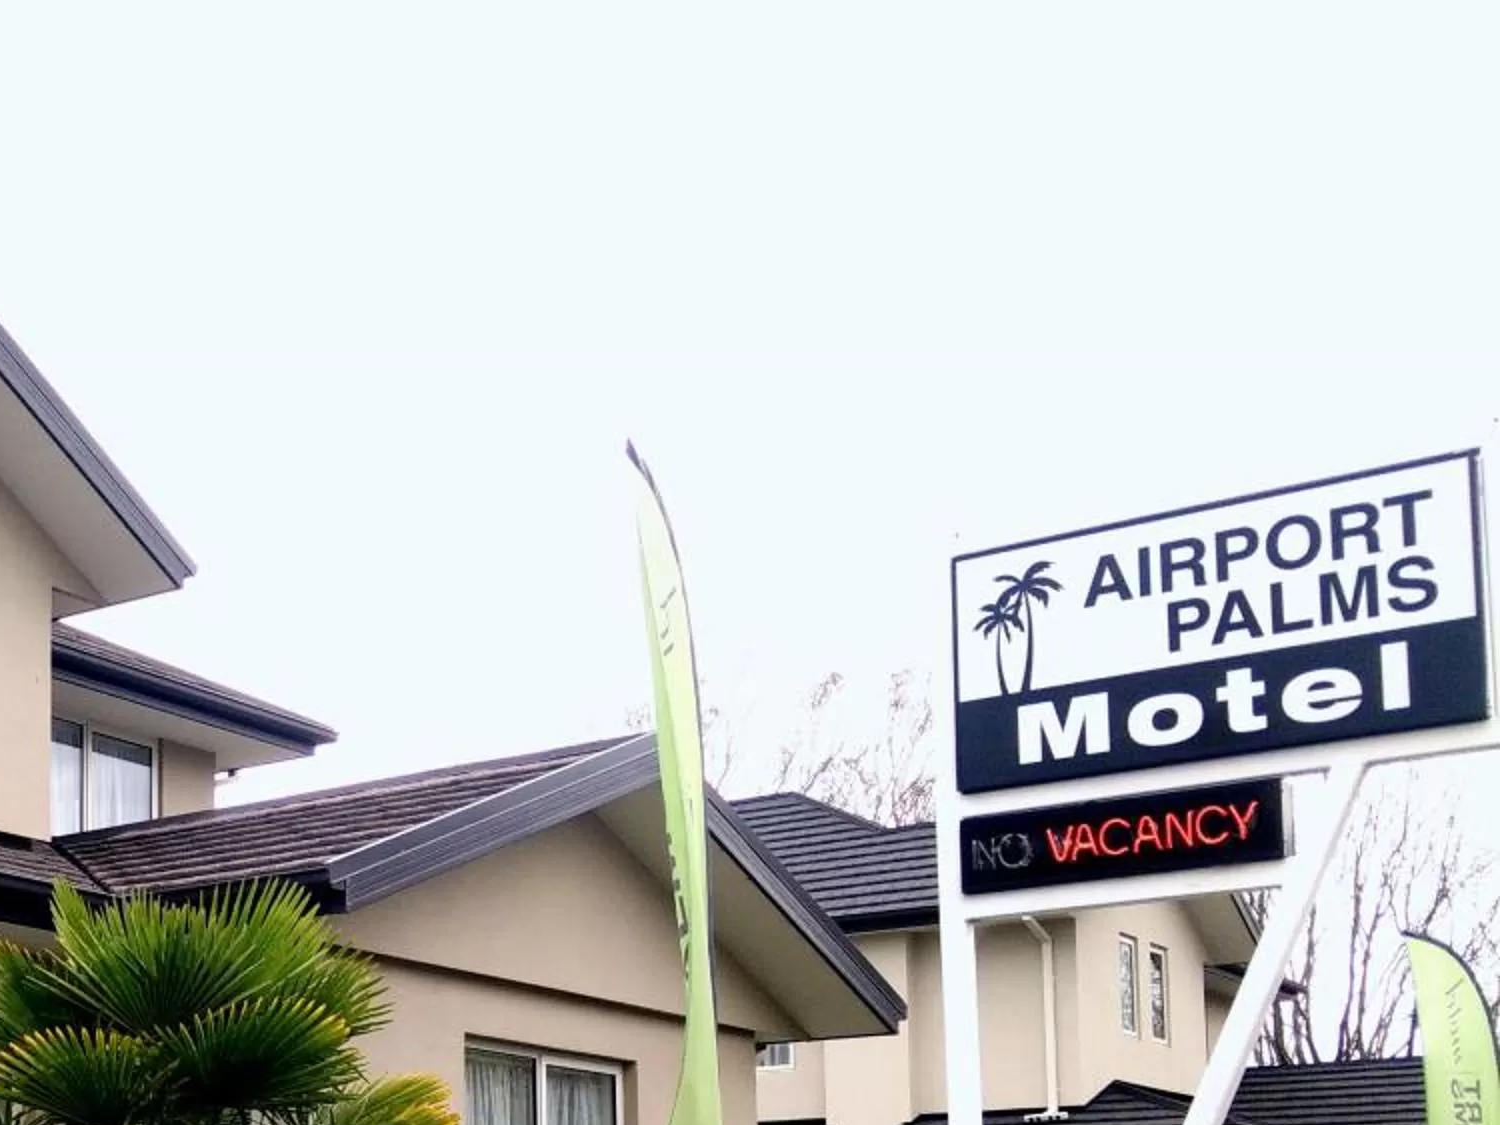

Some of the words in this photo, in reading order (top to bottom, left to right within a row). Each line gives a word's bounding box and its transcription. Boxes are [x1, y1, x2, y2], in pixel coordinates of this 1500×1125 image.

[1084, 489, 1433, 608] AIRPORT
[1167, 555, 1439, 653] PALMS
[1016, 641, 1411, 765] Motel
[970, 832, 1035, 871] NO
[1046, 800, 1260, 863] VACANCY
